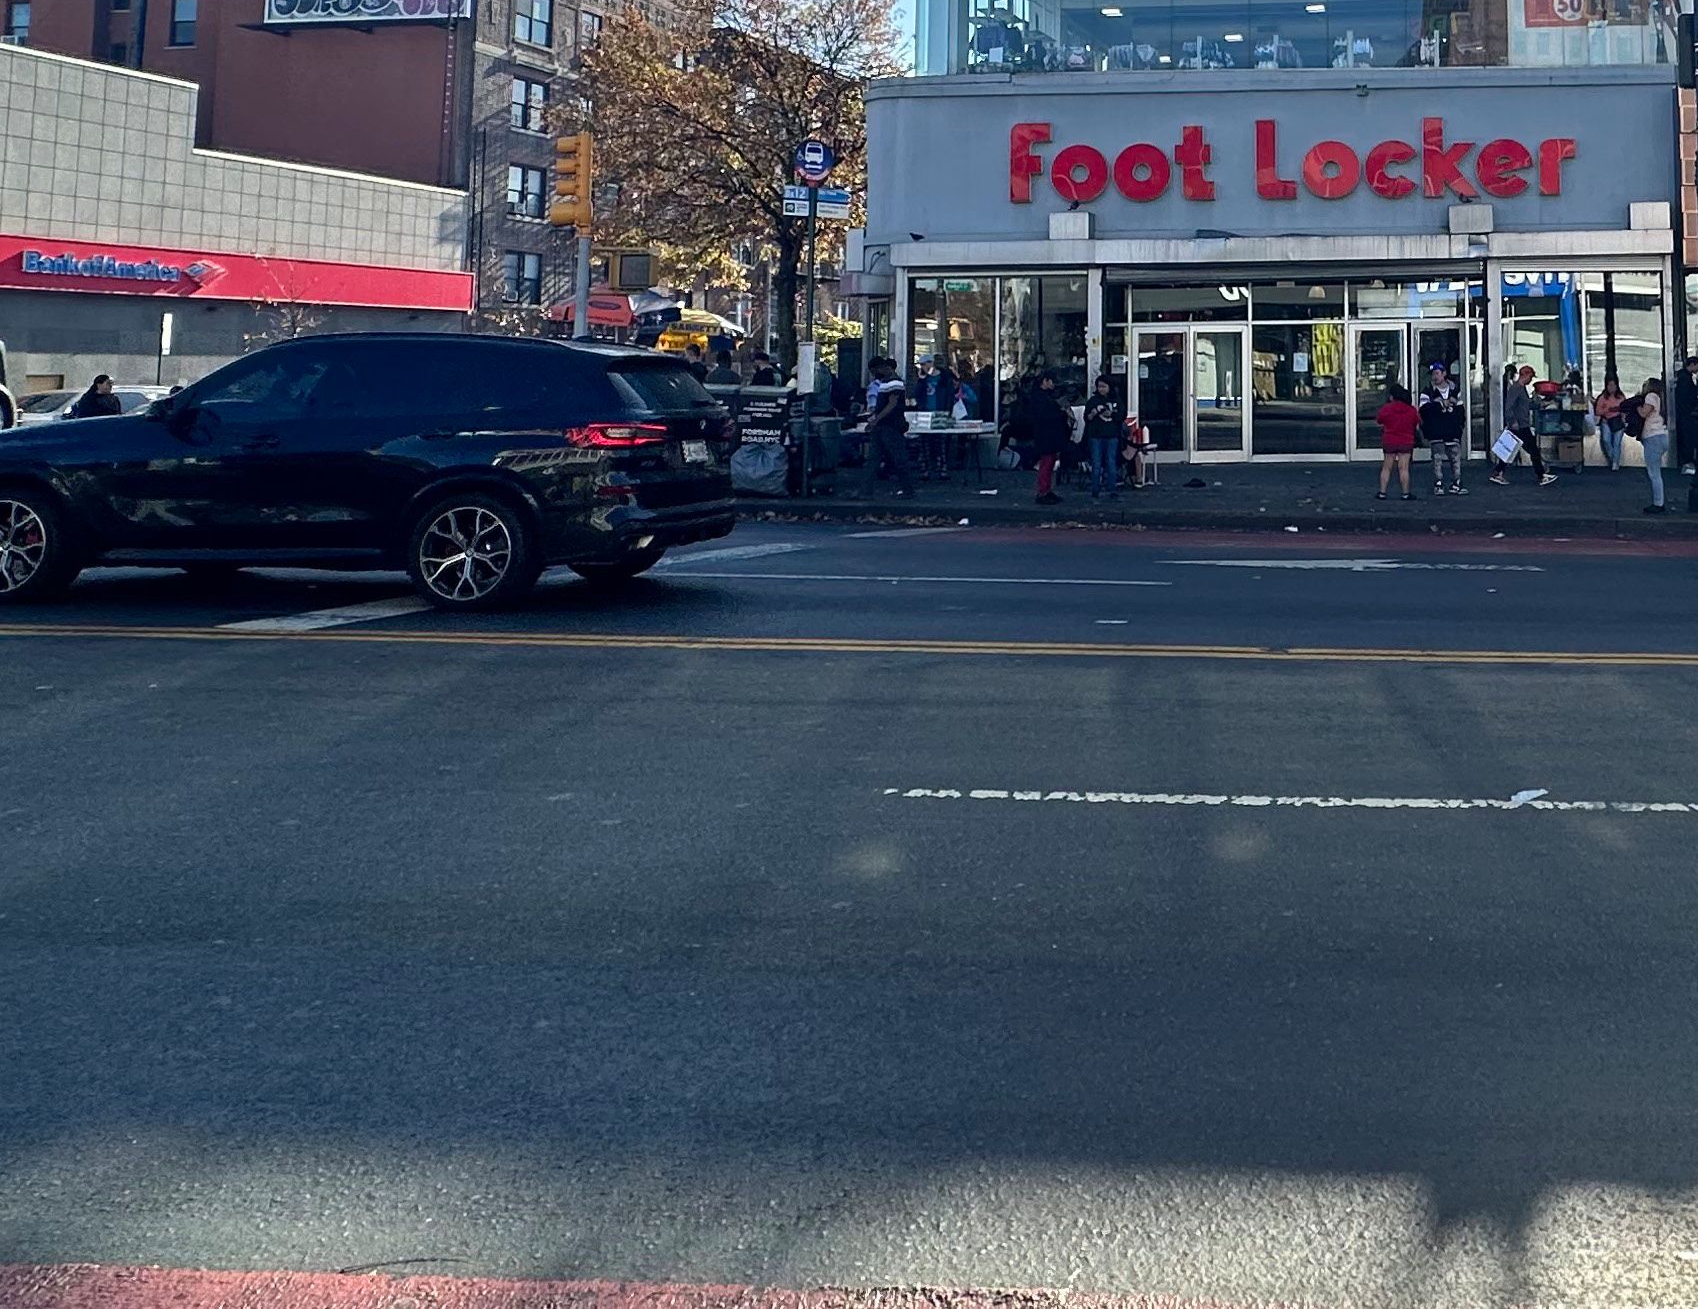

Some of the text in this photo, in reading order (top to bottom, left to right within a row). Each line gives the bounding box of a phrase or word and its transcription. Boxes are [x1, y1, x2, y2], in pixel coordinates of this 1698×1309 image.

[1009, 116, 1576, 204] Foot Locker
[23, 250, 180, 282] Bank of America
[742, 428, 781, 436] FORDHAM
